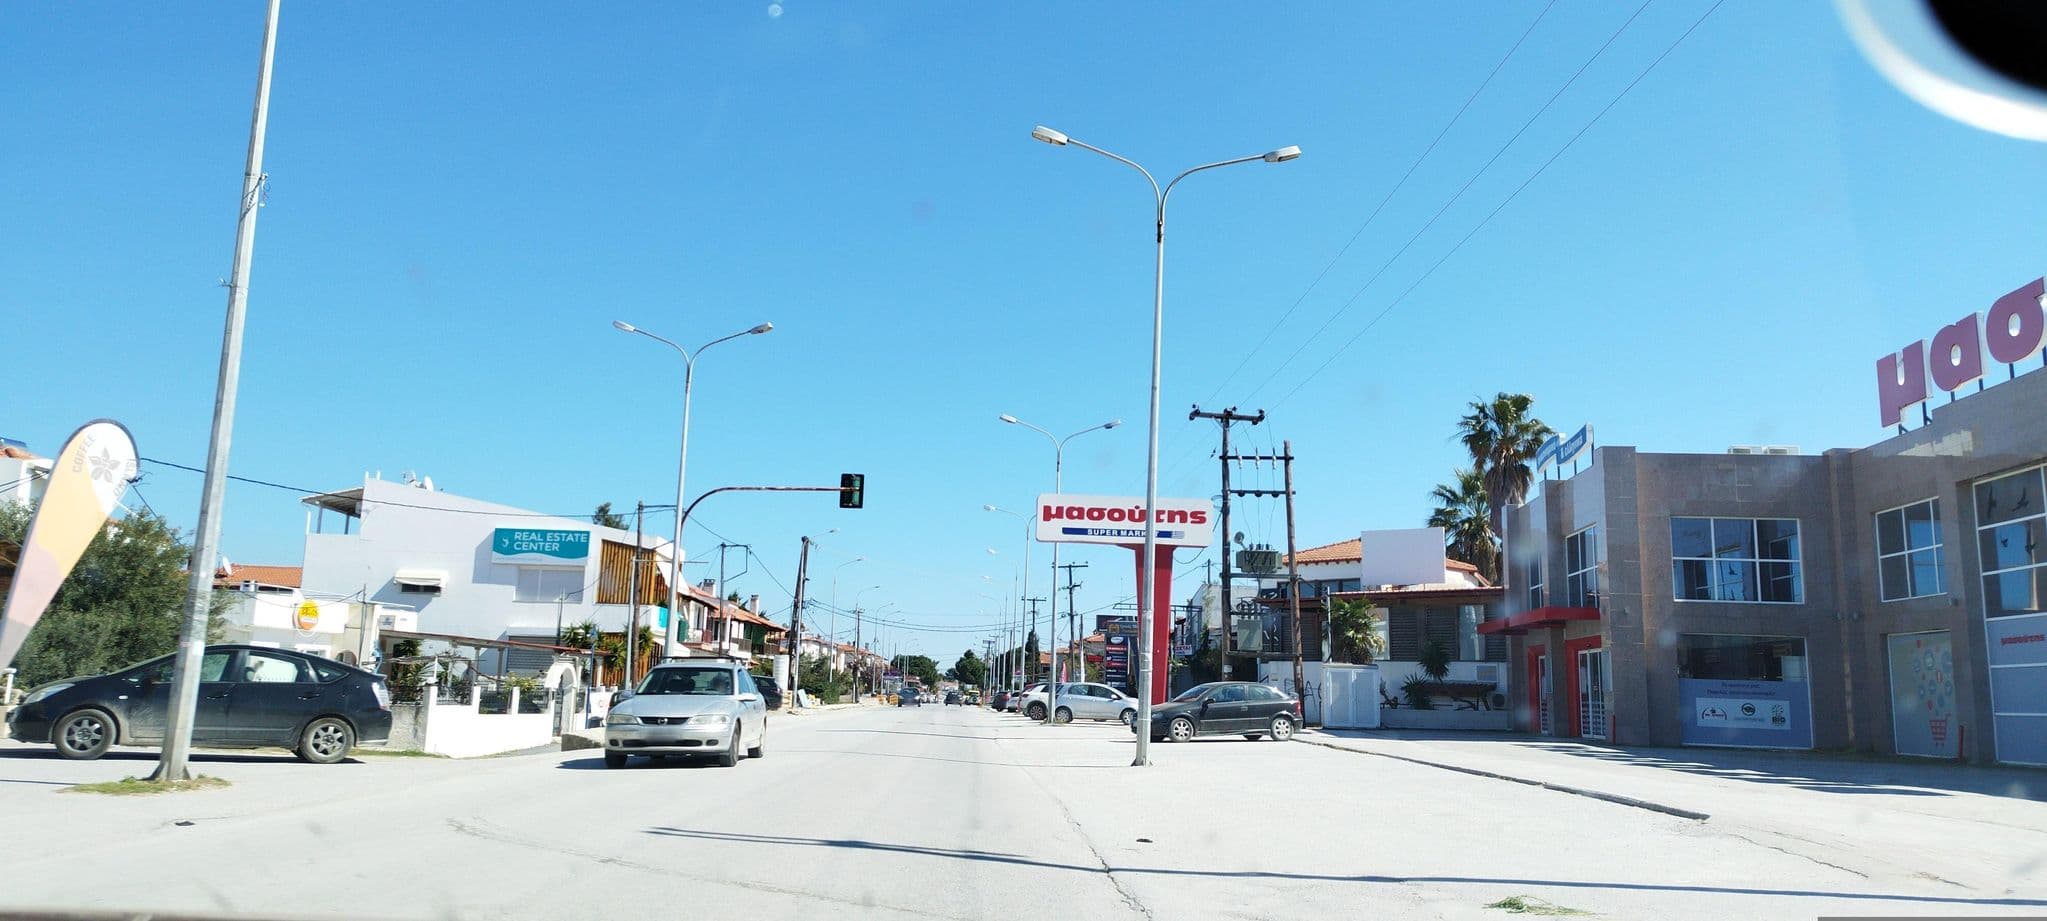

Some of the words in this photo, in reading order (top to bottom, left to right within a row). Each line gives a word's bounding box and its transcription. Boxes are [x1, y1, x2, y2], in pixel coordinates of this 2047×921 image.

[73, 433, 96, 473] COFFEE
[513, 531, 543, 541] REAL
[546, 532, 588, 543] ESTATE
[1087, 528, 1118, 537] SUPER
[1120, 529, 1159, 538] MARKT
[513, 541, 560, 551] CENTER
